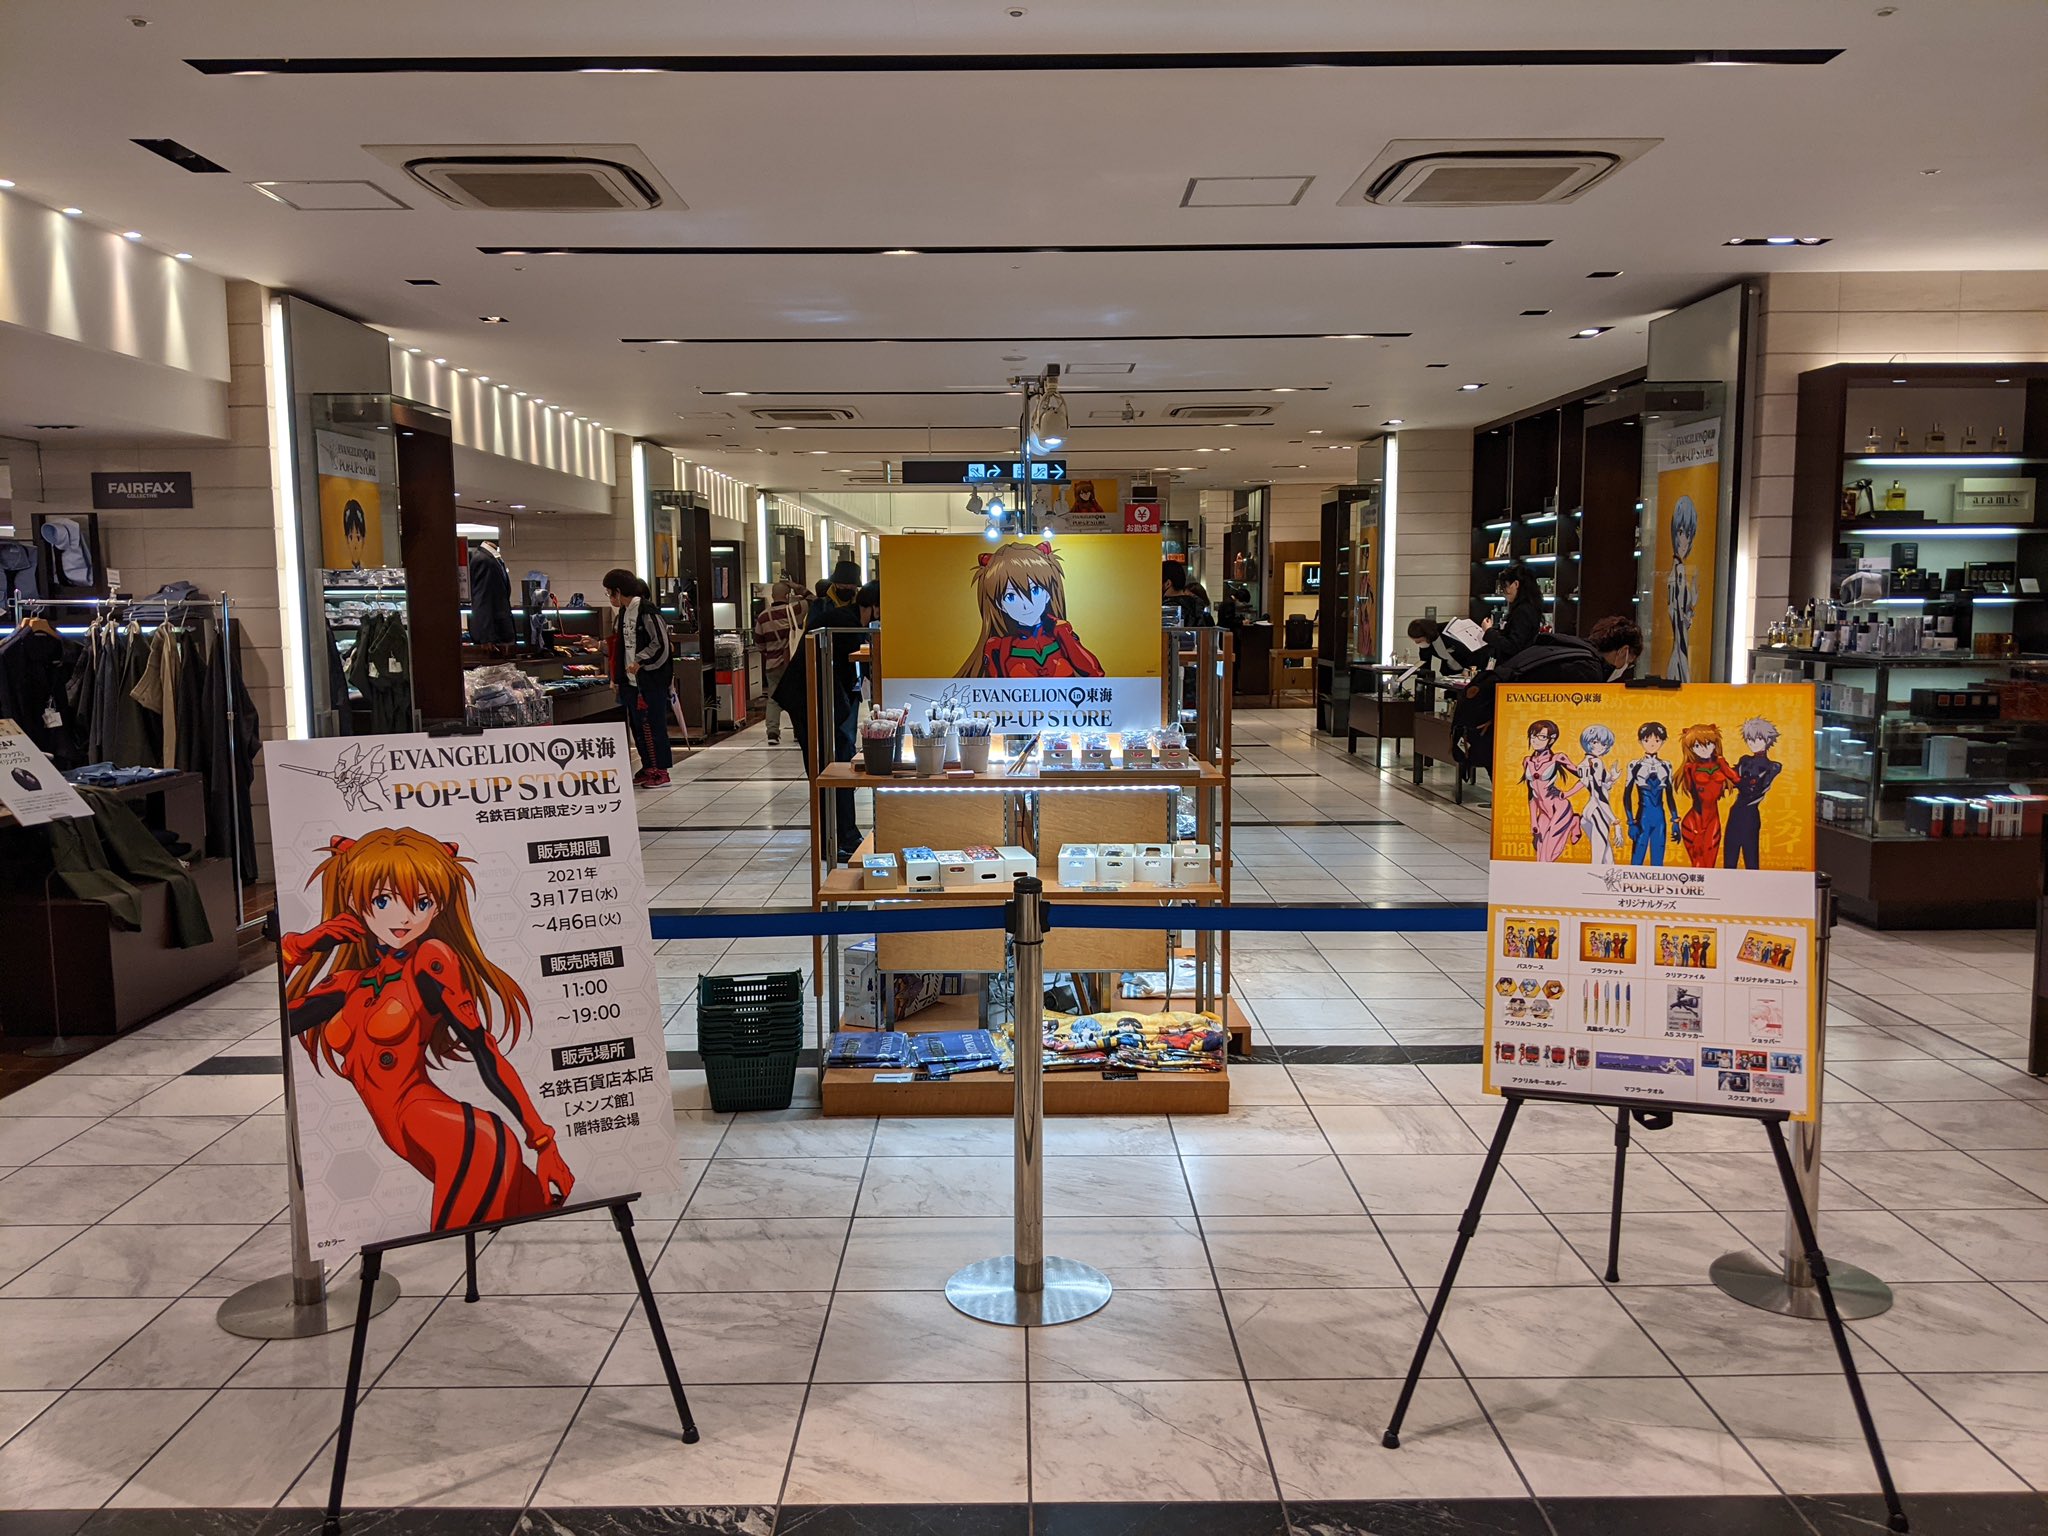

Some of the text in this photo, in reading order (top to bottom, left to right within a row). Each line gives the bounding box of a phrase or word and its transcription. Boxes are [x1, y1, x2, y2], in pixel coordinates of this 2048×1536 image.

[108, 482, 175, 493] FAIRFAX
[1973, 494, 2019, 504] aramis
[973, 688, 1067, 702] EVANGELION
[1087, 687, 1112, 703] 東海
[1506, 693, 1571, 703] EVANGELION
[1584, 693, 1602, 703] 東海
[1048, 710, 1113, 727] STORE
[389, 741, 546, 771] EVANGELION
[576, 737, 616, 760] 東海
[393, 769, 621, 810] POP-UP STORE
[475, 800, 622, 824] 名鉄百貨店限定ショップ
[537, 840, 601, 860] 販売期間
[547, 867, 598, 883] 2021年
[1622, 872, 1679, 882] EVANGELION
[529, 887, 618, 908] 3月17日(水)
[1622, 883, 1705, 896] POP-UP STORE
[1618, 898, 1677, 910] オリジナルグッズ
[550, 951, 615, 972] 販売時間
[1591, 967, 1625, 975] ブランケット
[1665, 972, 1706, 980] クリアファイル
[562, 979, 608, 998] 11:00
[1734, 976, 1799, 985] オリジナルチョコレート
[1504, 1020, 1554, 1028] アクリルコースター
[1751, 1037, 1781, 1045] ショッパー
[561, 1042, 626, 1066] 販売場所
[539, 1067, 654, 1099] 名鉄百貨店本店
[1512, 1076, 1568, 1087] アクリルキーホルダー
[1624, 1086, 1665, 1095] マフラータオル
[564, 1091, 635, 1117] [メンズ館]
[566, 1113, 641, 1138] 1階特設会場
